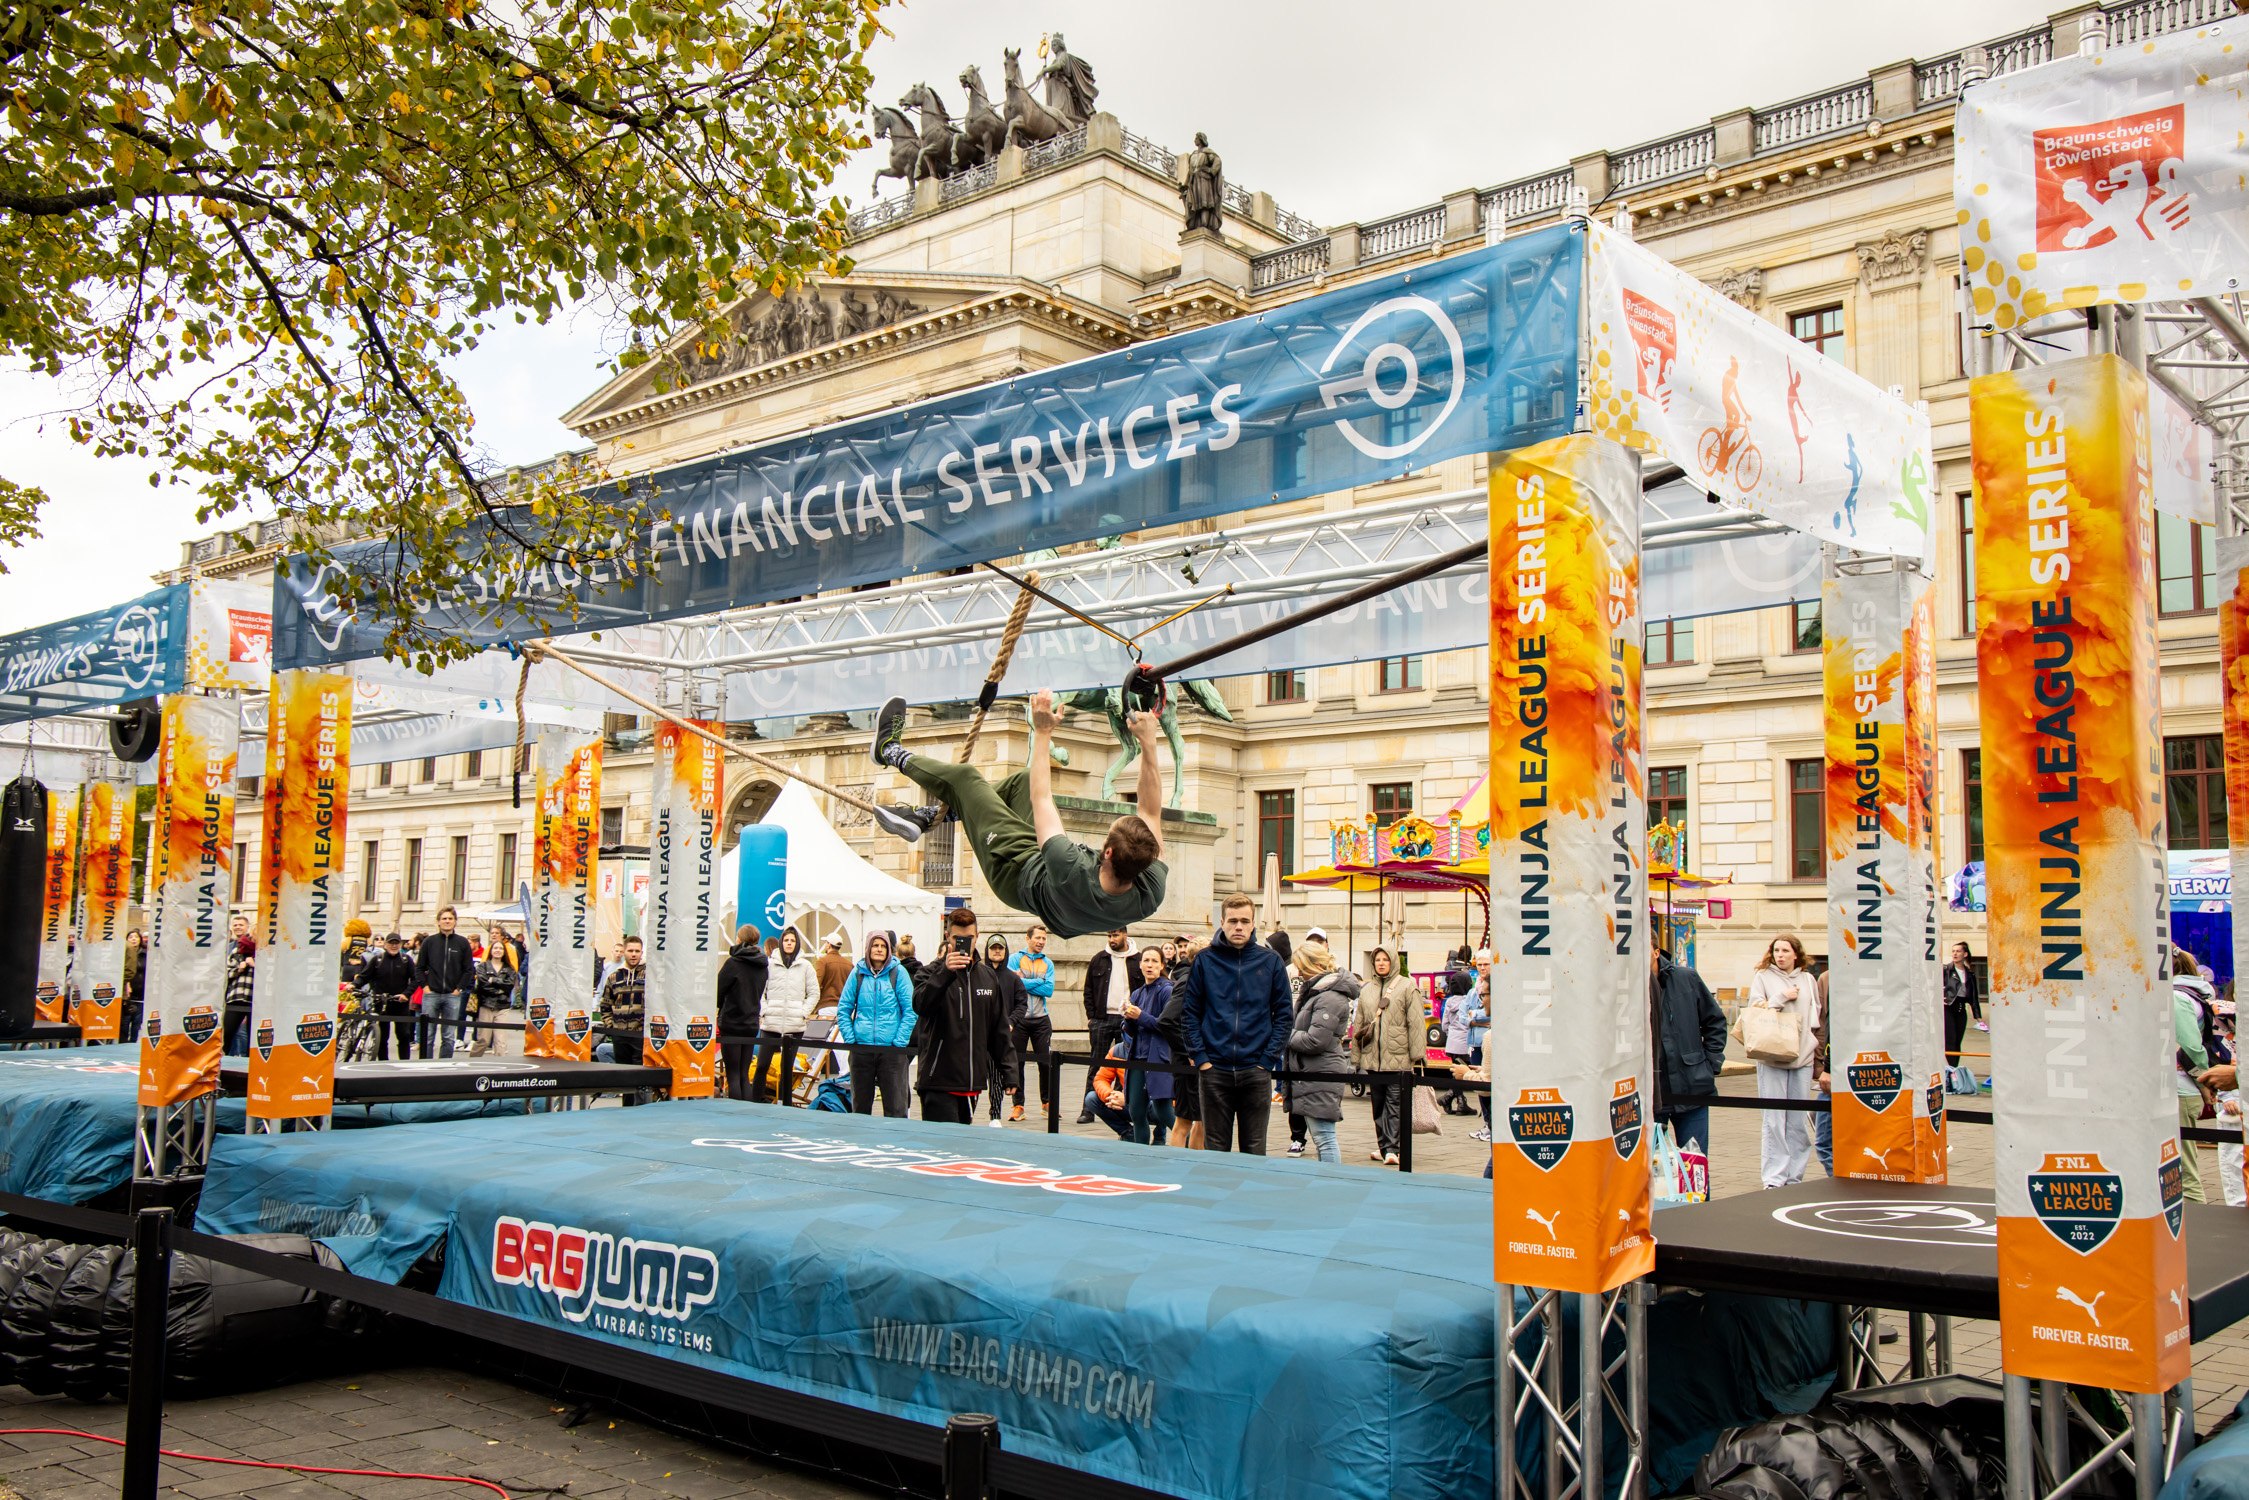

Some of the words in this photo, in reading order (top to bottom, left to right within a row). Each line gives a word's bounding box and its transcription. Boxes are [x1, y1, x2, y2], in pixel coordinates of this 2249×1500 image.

[2044, 117, 2173, 153] Braunschweig
[2045, 136, 2152, 170] Löwenstadt
[1625, 299, 1674, 333] Braunschweig
[1625, 313, 1668, 342] Löwenstadt
[650, 466, 926, 572] FINANCIAL
[938, 383, 1242, 514] SERVICES
[2024, 405, 2070, 585] SERIES
[2133, 408, 2153, 588] SERIES
[1517, 474, 1546, 624] SERIES
[0, 641, 93, 694] SERVICES
[1853, 600, 1878, 713] SERIES
[1918, 602, 1933, 714] SERIES
[276, 689, 287, 771] SERIES
[318, 692, 339, 772] SERIES
[1518, 635, 1549, 808] LEAGUE
[1609, 637, 1627, 809] LEAGUE
[2032, 597, 2079, 803] LEAGUE
[2146, 598, 2163, 804] LEAGUE
[206, 715, 226, 789] SERIES
[578, 748, 592, 812] SERIES
[662, 735, 674, 802] SERIES
[702, 738, 716, 804] SERIES
[1856, 721, 1881, 850] LEAGUE
[1921, 722, 1933, 850] LEAGUE
[54, 801, 68, 847] SERIES
[110, 795, 124, 841] SERIES
[154, 882, 165, 947] NINJA
[160, 792, 172, 875] LEAGUE
[166, 714, 177, 787] SERIES
[201, 793, 221, 877] LEAGUE
[272, 777, 284, 867] LEAGUE
[314, 777, 335, 869] LEAGUE
[541, 814, 552, 886] LEAGUE
[660, 807, 671, 885] LEAGUE
[699, 808, 713, 886] LEAGUE
[51, 849, 64, 899] LEAGUE
[106, 844, 120, 897] LEAGUE
[575, 816, 590, 887] LEAGUE
[195, 881, 215, 947] NINJA
[268, 874, 279, 946] NINJA
[309, 874, 330, 946] NINJA
[539, 891, 551, 947] NINJA
[1520, 819, 1551, 955] NINJA
[1612, 820, 1632, 955] NINJA
[1857, 858, 1882, 960] NINJA
[1925, 858, 1936, 960] NINJA
[2039, 816, 2084, 981] NINJA
[2151, 820, 2168, 981] NINJA
[47, 902, 60, 942] NINJA
[103, 900, 116, 941] NINJA
[572, 893, 587, 949] NINJA
[656, 891, 668, 951] NINJA
[696, 891, 711, 951] NINJA
[306, 951, 326, 996] FNL
[694, 956, 708, 995] FNL
[976, 988, 993, 996] STAFF
[1859, 968, 1884, 1033] FNL
[301, 1031, 330, 1040] LEAGUE
[303, 1025, 326, 1033] NINJA
[1522, 968, 1552, 1054] FNL
[1615, 968, 1633, 1054] FNL
[1858, 1069, 1891, 1082] NINJA
[1862, 1054, 1883, 1062] FNL
[2045, 995, 2089, 1101] FNL
[491, 1077, 558, 1089] turnmatte.com
[1528, 1091, 1553, 1102] FNL
[1618, 1081, 1633, 1094] FNL
[1855, 1078, 1897, 1088] LEAGUE
[1519, 1123, 1567, 1137] LEAGUE
[1523, 1112, 1562, 1127] NINJA
[1615, 1114, 1639, 1129] LEAGUE
[1620, 1141, 1631, 1150] 2022
[1537, 1152, 1555, 1160] 2022
[2055, 1156, 2090, 1169] FNL
[2163, 1167, 2180, 1185] NINJA
[2044, 1196, 2113, 1212] LEAGUE
[2050, 1182, 2104, 1200] NINJA
[2164, 1182, 2182, 1201] LEAGUE
[1509, 1241, 1546, 1256] FOREVER.
[1547, 1247, 1578, 1260] FASTER.
[2070, 1231, 2095, 1241] 2022
[491, 1215, 719, 1322] BAGJUMP
[595, 1313, 645, 1338] AIRBAG
[650, 1324, 713, 1353] SYSTEMS
[2032, 1325, 2086, 1346] FOREVER.
[2087, 1333, 2134, 1352] FASTER.
[873, 1316, 1155, 1429] WWW.BAGJUMP.COM
